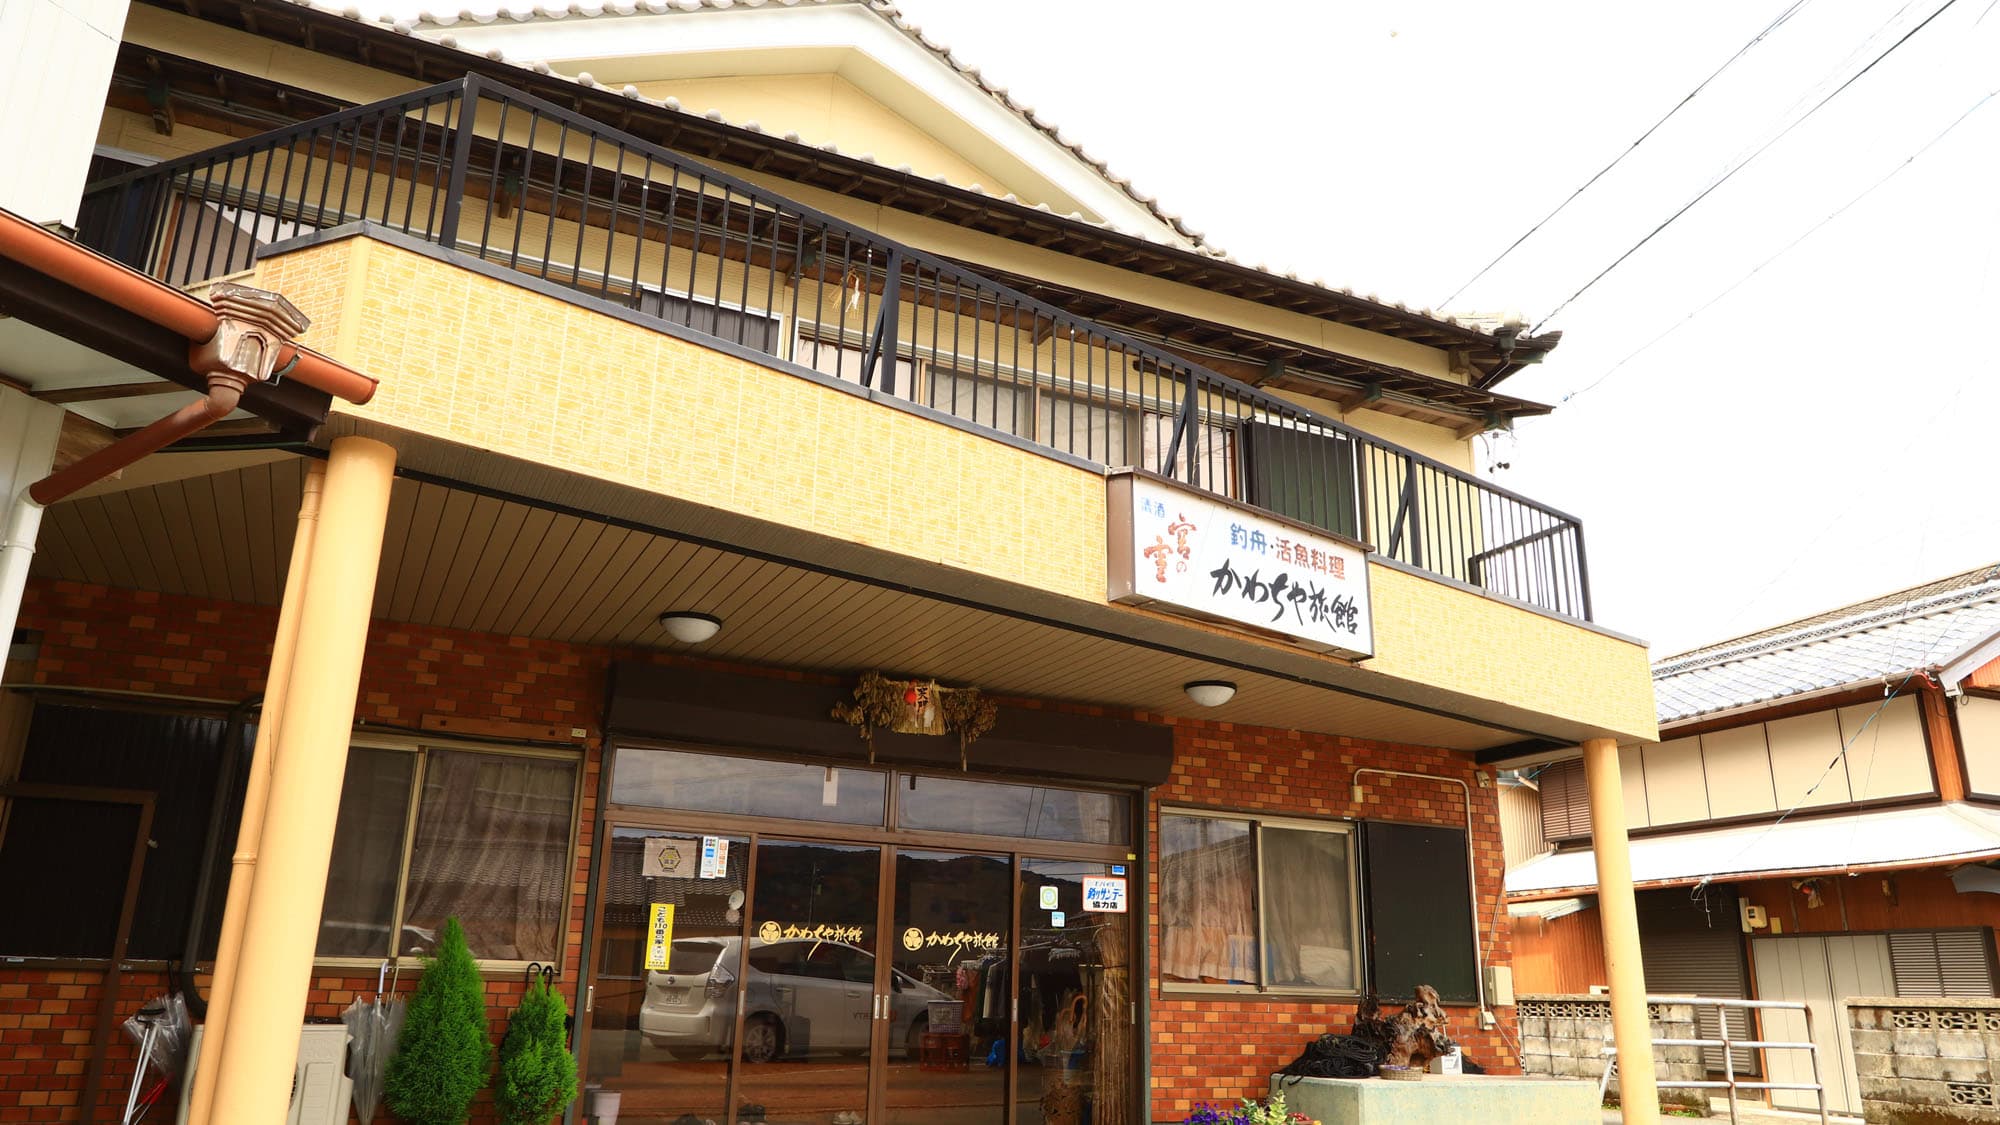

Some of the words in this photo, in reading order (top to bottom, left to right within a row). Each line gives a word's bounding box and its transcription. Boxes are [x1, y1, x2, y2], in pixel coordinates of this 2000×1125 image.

[1230, 522, 1346, 581] 釣舟・活魚料理
[1210, 558, 1358, 634] かわちや旅館
[1092, 901, 1118, 910] 協力店
[783, 924, 863, 960] かわちや旅館
[926, 931, 999, 966] かわちや旅館
